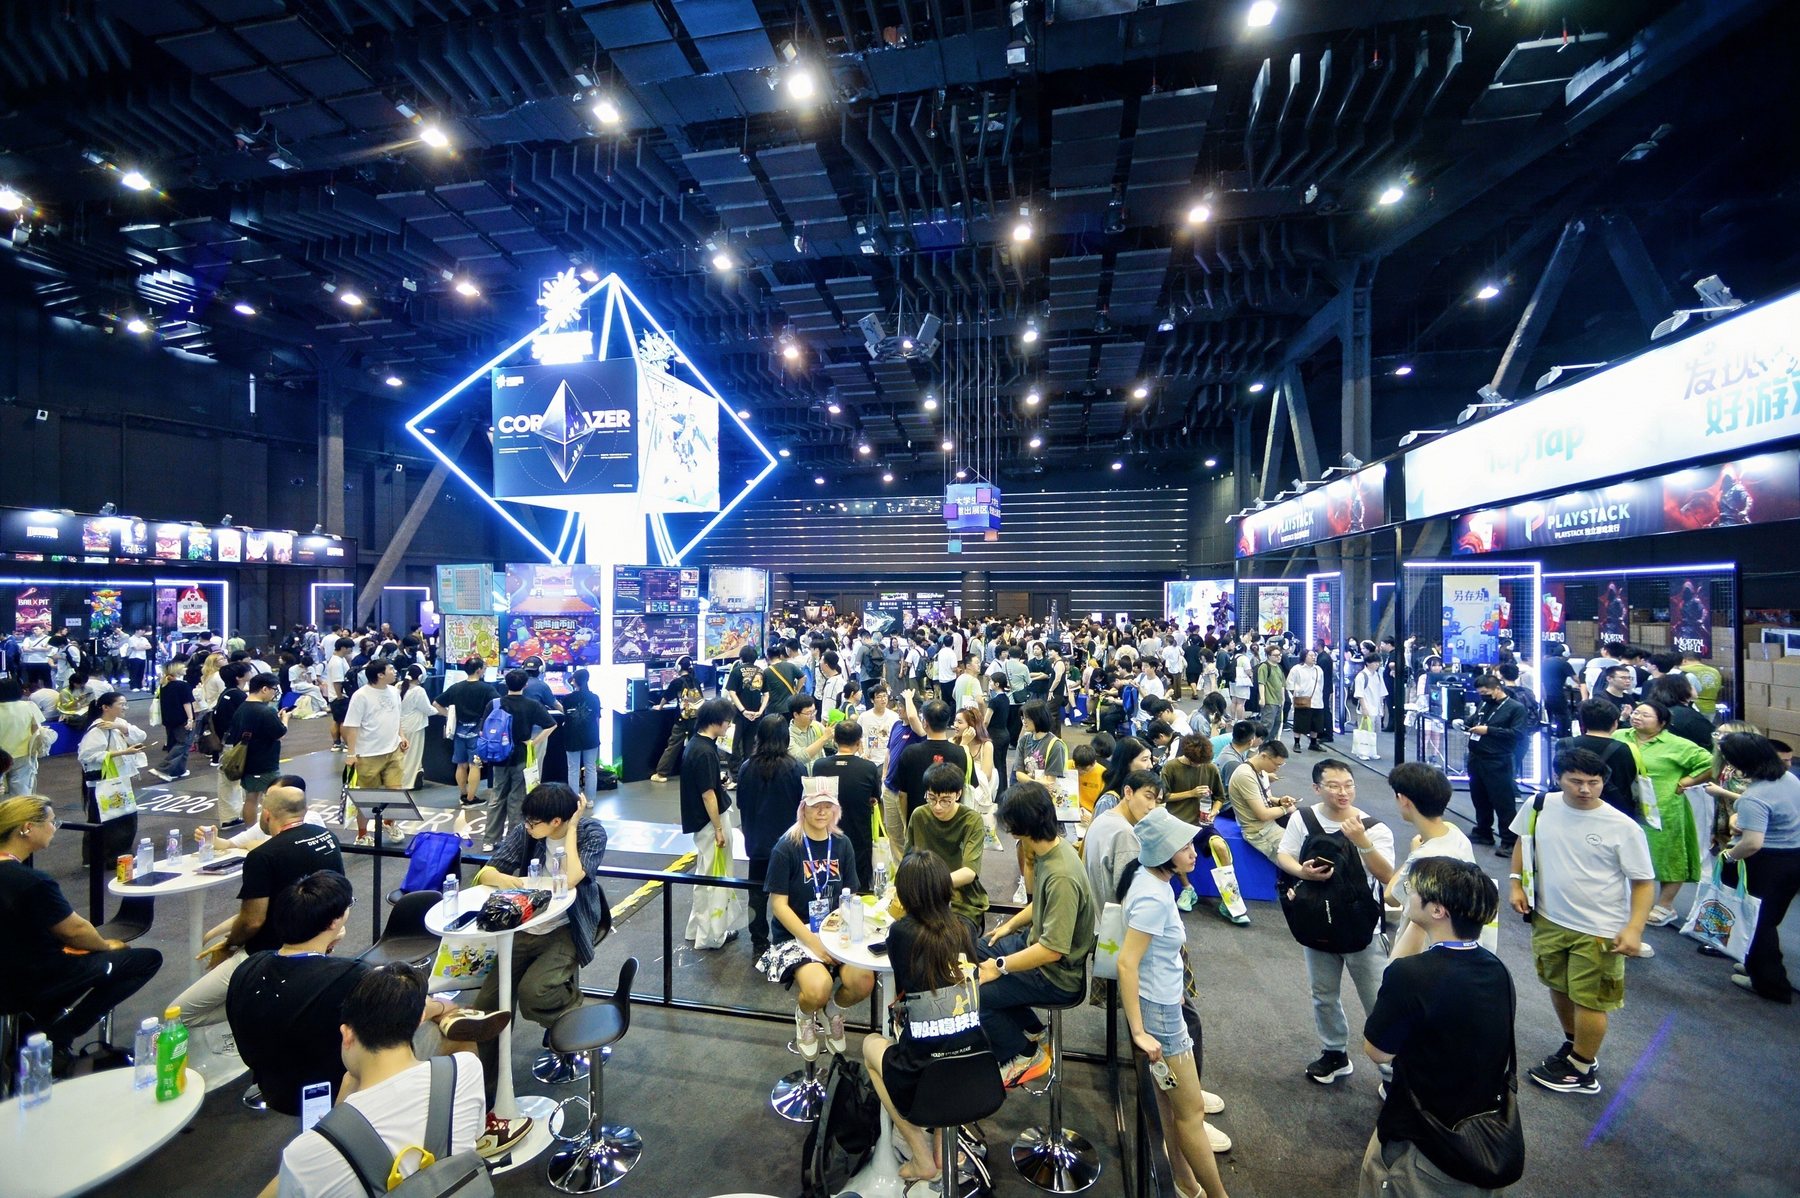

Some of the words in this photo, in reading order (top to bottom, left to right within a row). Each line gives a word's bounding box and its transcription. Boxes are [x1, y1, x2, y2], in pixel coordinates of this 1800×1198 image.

[1548, 503, 1631, 530] PLAYSTACK
[1555, 529, 1584, 539] PLAYSTACK
[1454, 589, 1484, 602] 另存为
[38, 598, 50, 606] PIT
[1673, 636, 1704, 647] MORTAL
[136, 793, 219, 814] 2026
